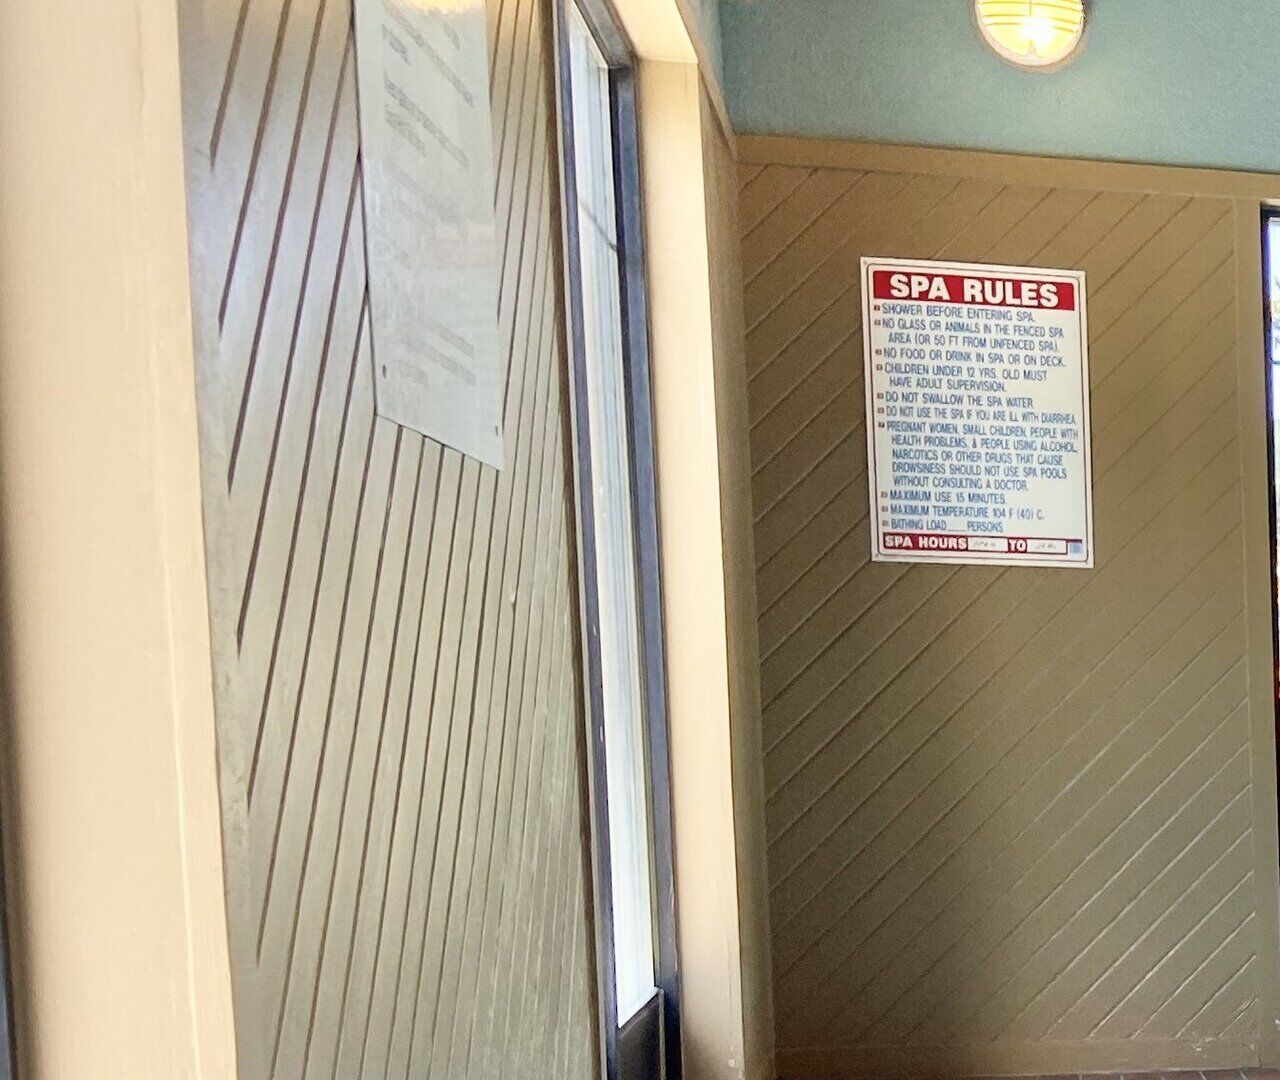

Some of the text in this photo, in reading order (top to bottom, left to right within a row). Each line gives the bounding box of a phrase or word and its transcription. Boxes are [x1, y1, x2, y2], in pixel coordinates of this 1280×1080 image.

[890, 273, 1059, 308] SPA RULES
[884, 535, 913, 548] SPA
[919, 536, 967, 549] HOURS
[1010, 541, 1026, 552] TO
